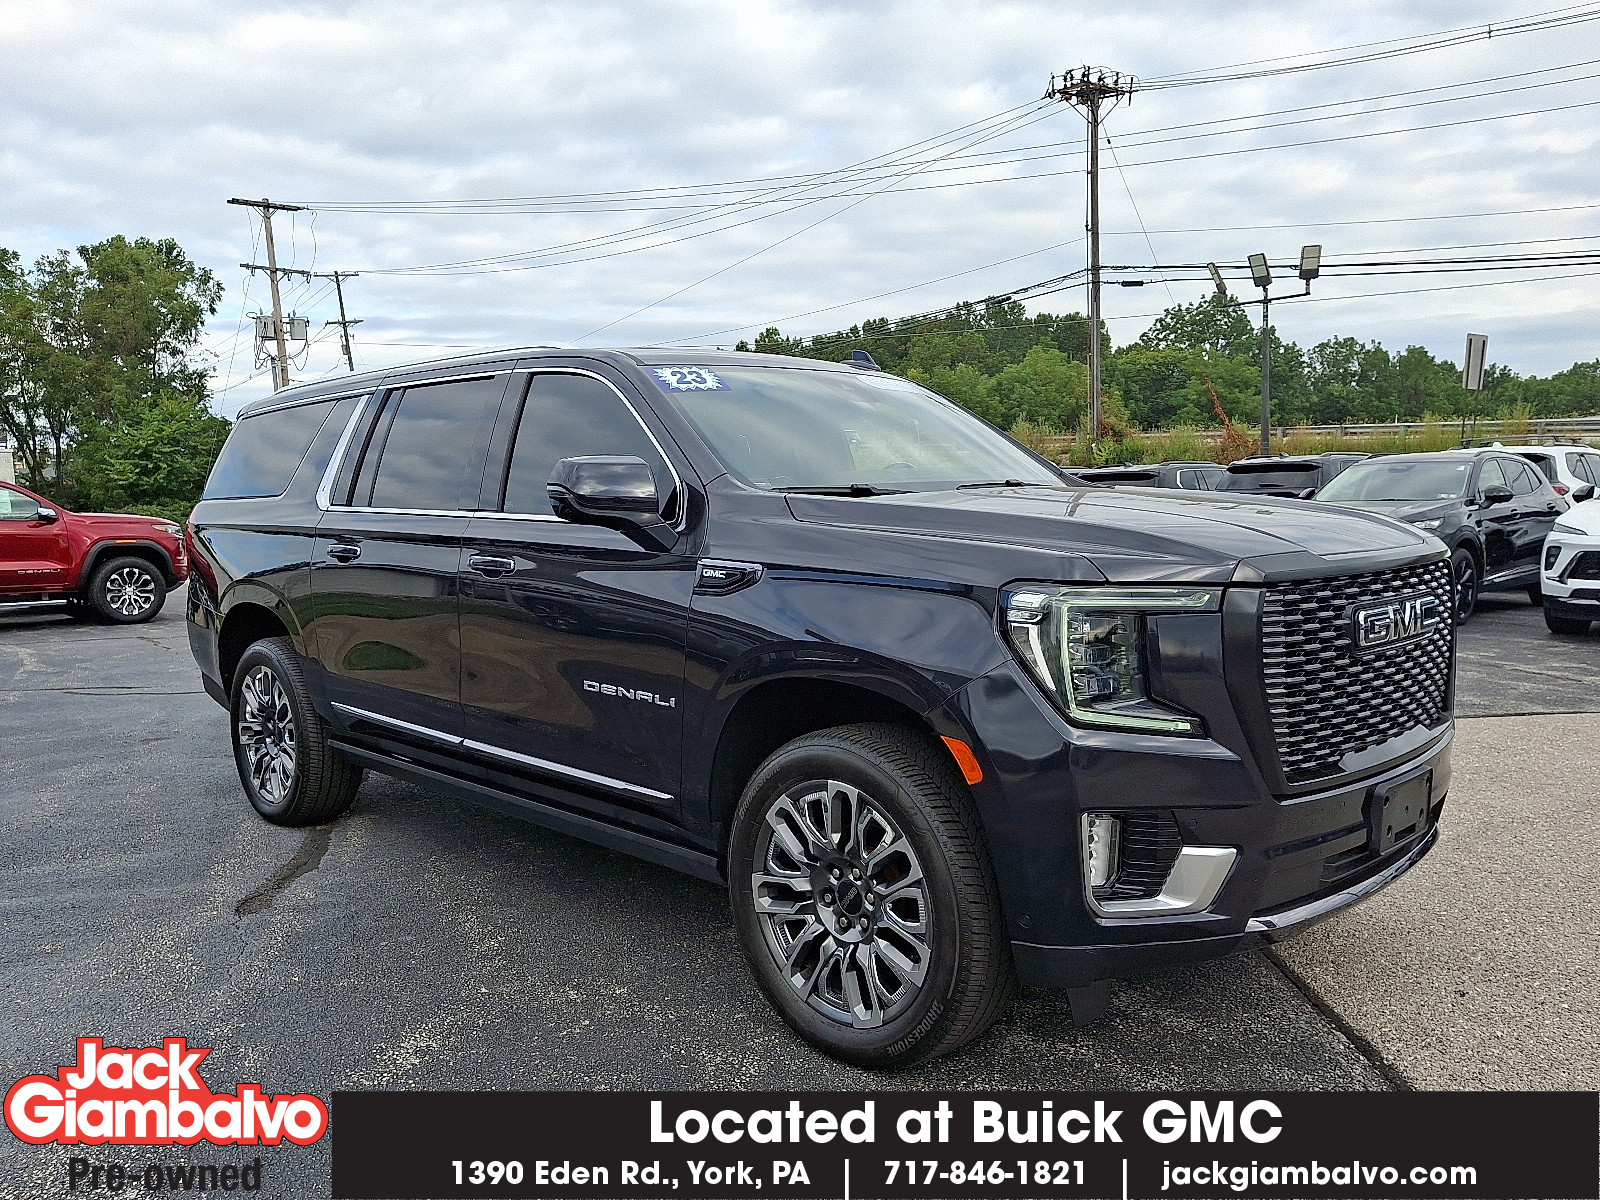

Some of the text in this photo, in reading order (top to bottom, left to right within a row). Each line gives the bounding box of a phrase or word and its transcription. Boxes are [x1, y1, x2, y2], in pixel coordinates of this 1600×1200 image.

[671, 370, 707, 385] 23
[702, 568, 727, 579] GMC
[1358, 596, 1441, 647] GMC
[583, 680, 676, 708] DENALI
[886, 999, 944, 1057] BRIDGESTONE
